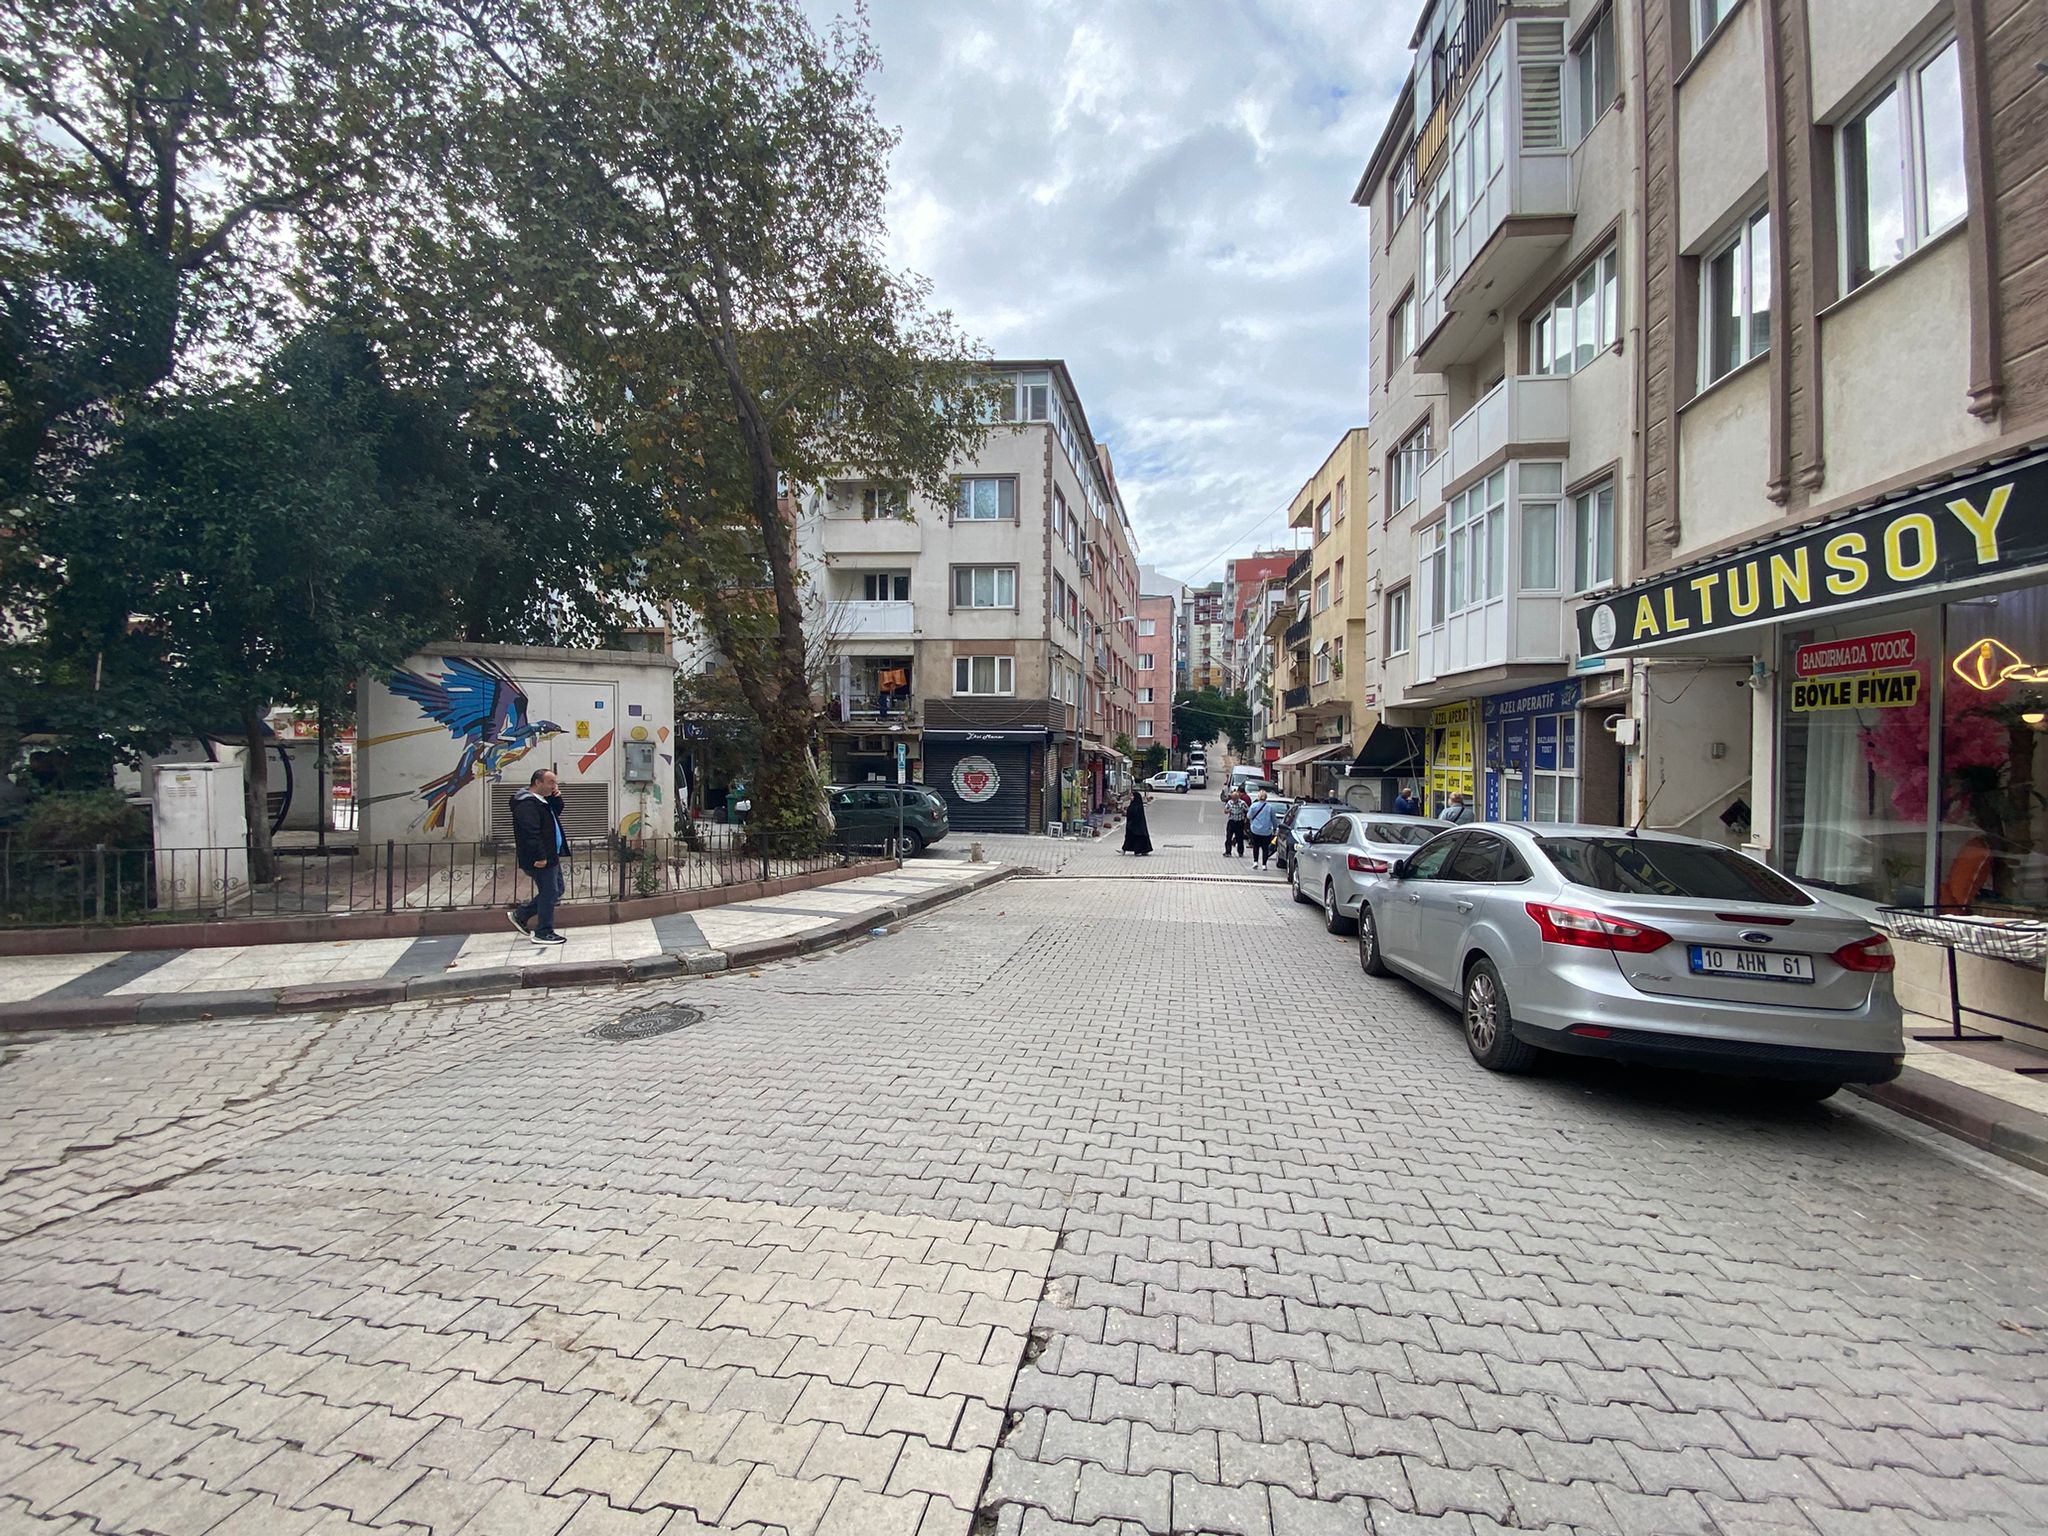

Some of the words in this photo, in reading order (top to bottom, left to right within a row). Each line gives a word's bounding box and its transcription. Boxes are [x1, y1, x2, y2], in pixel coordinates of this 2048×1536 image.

[1632, 483, 2015, 640] ALTUNSOY
[1500, 700, 1517, 715] AZEL
[1517, 690, 1555, 713] APERATİF
[1795, 678, 1851, 707] BÖYLE
[1857, 671, 1916, 704] FİYAT
[1705, 949, 1723, 968] 10
[1737, 953, 1767, 973] AHN
[1783, 957, 1801, 975] 61
